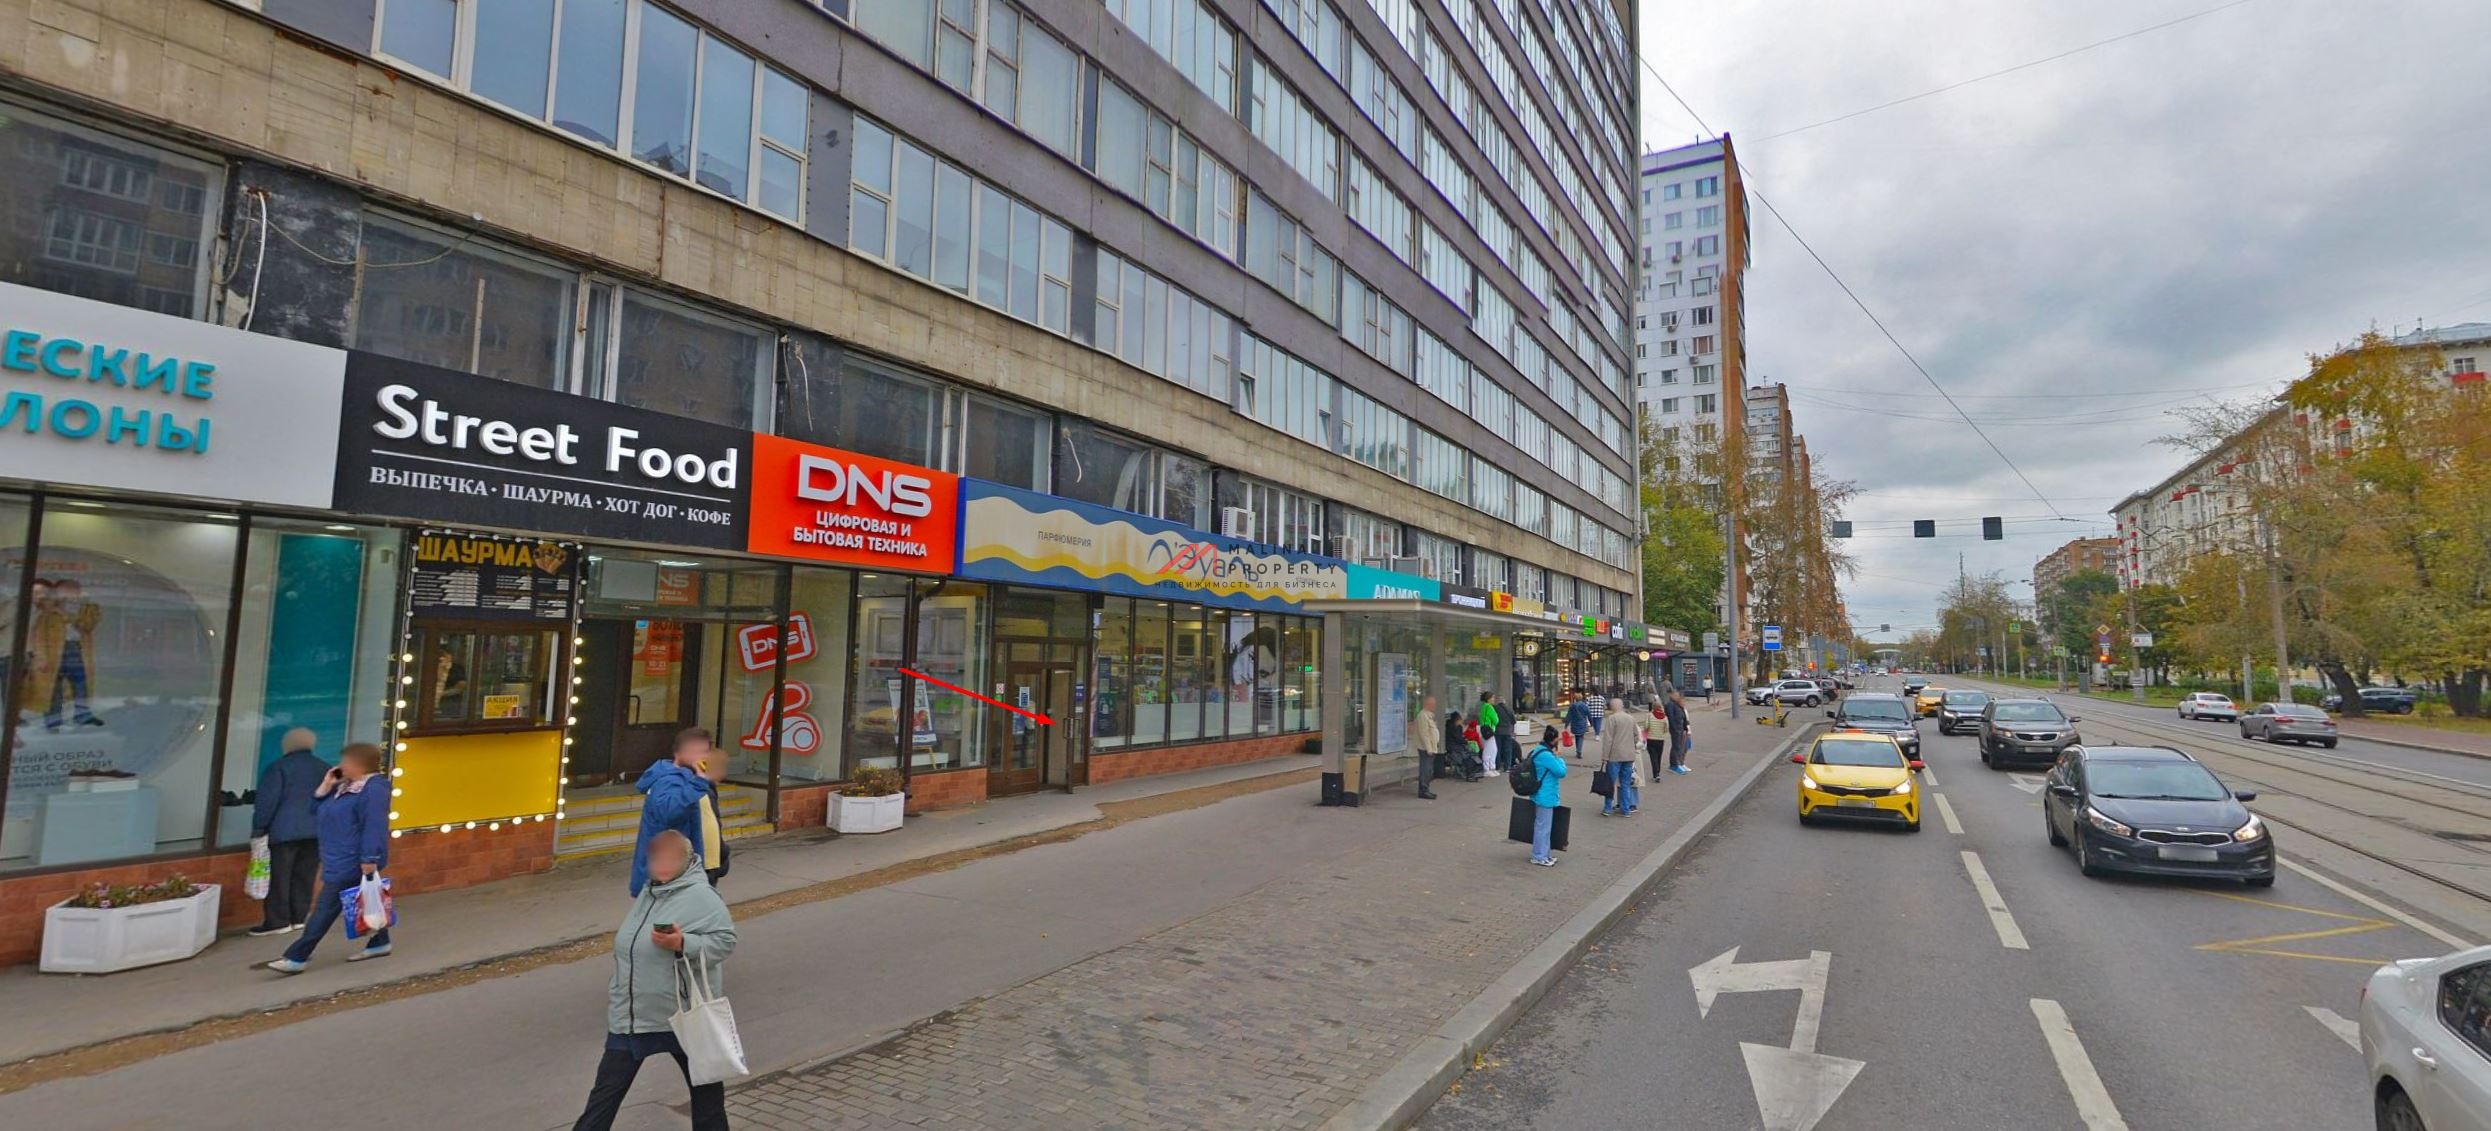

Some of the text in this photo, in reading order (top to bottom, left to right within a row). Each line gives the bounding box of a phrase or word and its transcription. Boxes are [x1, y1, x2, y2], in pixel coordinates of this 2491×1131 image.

[2, 329, 216, 400] ЕСКИЕ
[0, 391, 211, 455] ЛОНЫ
[373, 384, 738, 490] Street Food
[369, 466, 732, 526] ВЫПЕЧКА ШАУРМА ХОТ ДОГ КОФЕ
[797, 453, 932, 518] DNS
[416, 536, 533, 568] ШАУРМА
[793, 527, 928, 557] БЫТОВАЯ ТЕХНИКА
[816, 510, 911, 537] ЦИФРОВАЯ И
[1037, 530, 1092, 548] ПАРФЮМЕРИЯ
